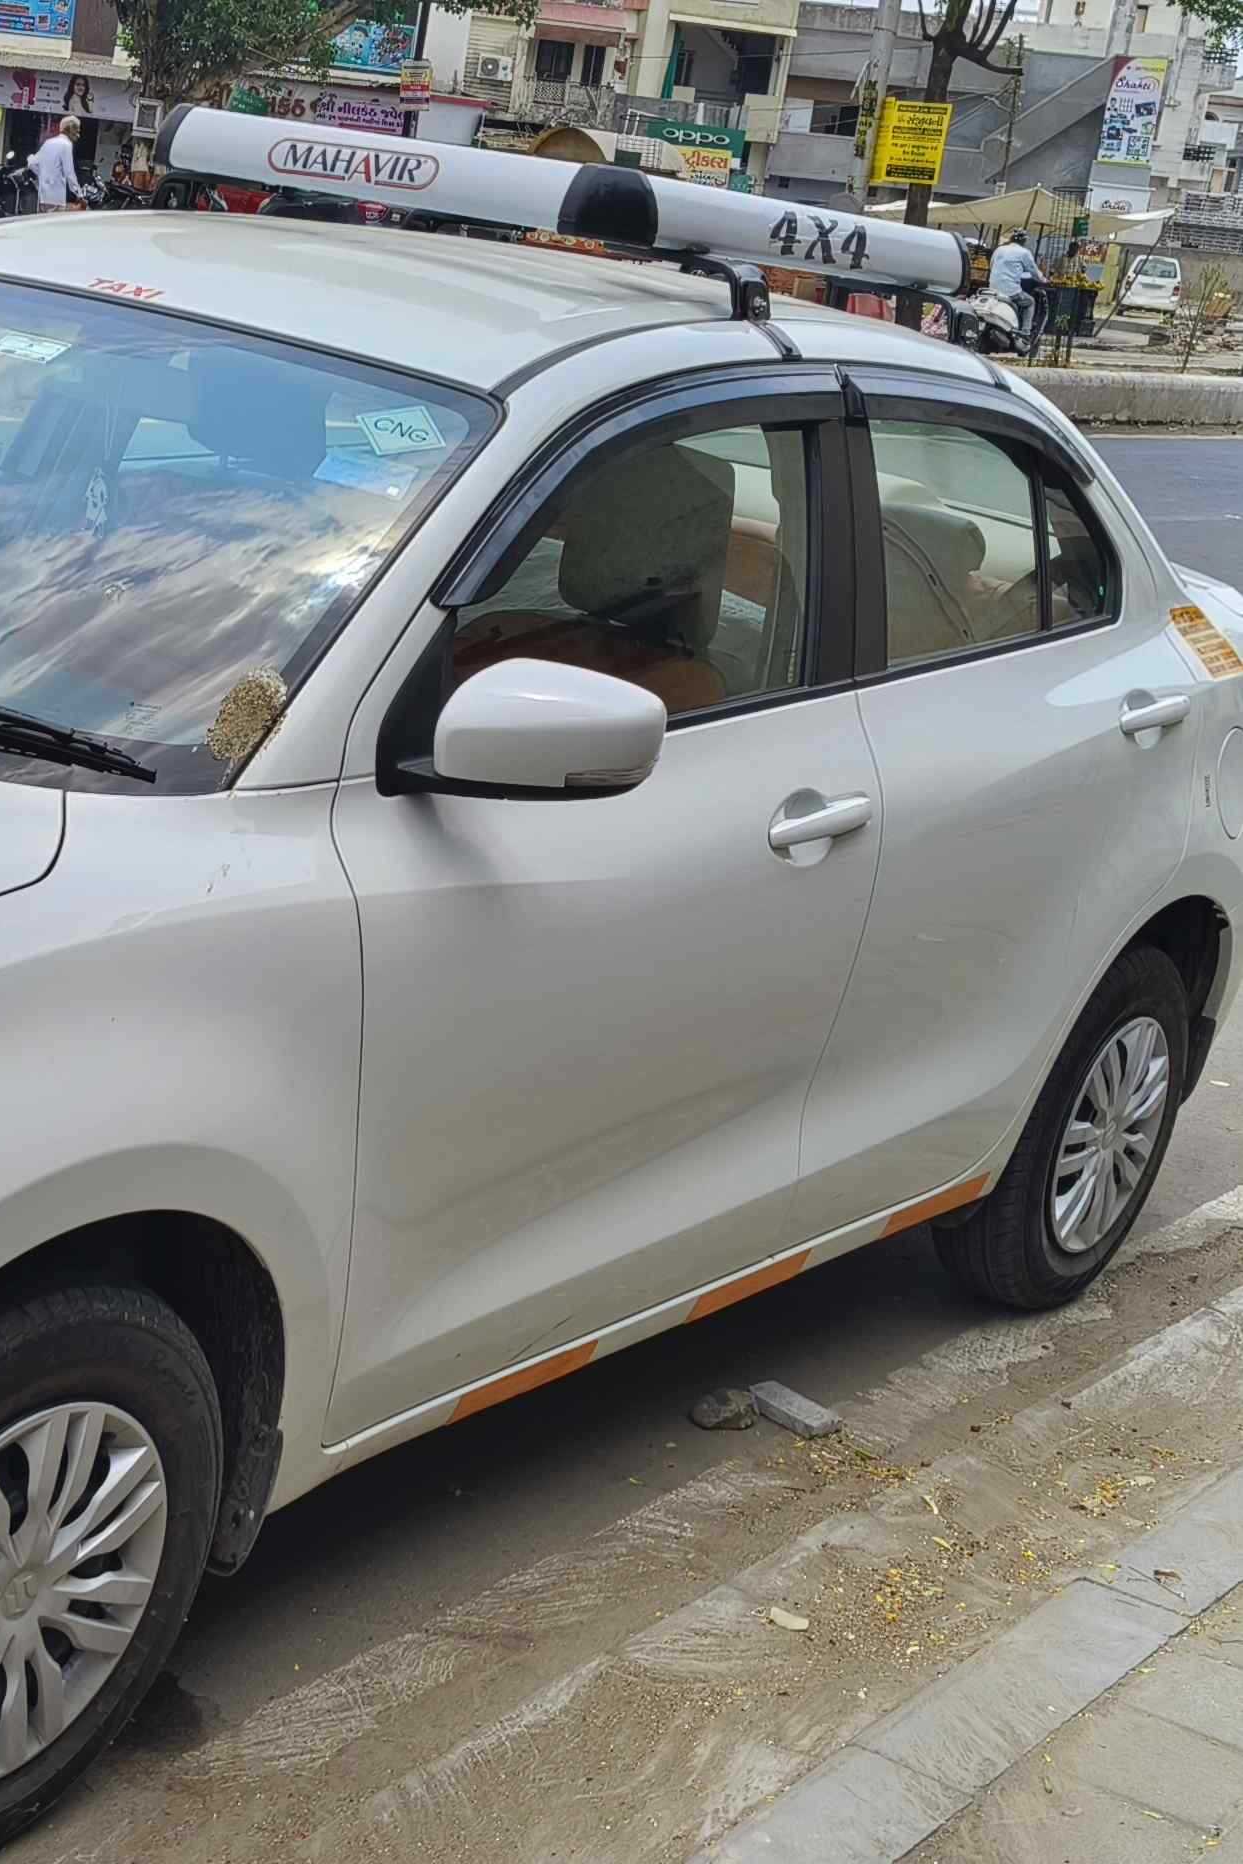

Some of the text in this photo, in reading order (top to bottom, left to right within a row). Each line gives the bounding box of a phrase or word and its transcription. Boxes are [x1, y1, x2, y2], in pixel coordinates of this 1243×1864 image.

[283, 143, 422, 184] MAHAVIR
[88, 277, 165, 299] TAXI
[374, 417, 429, 443] CNG
